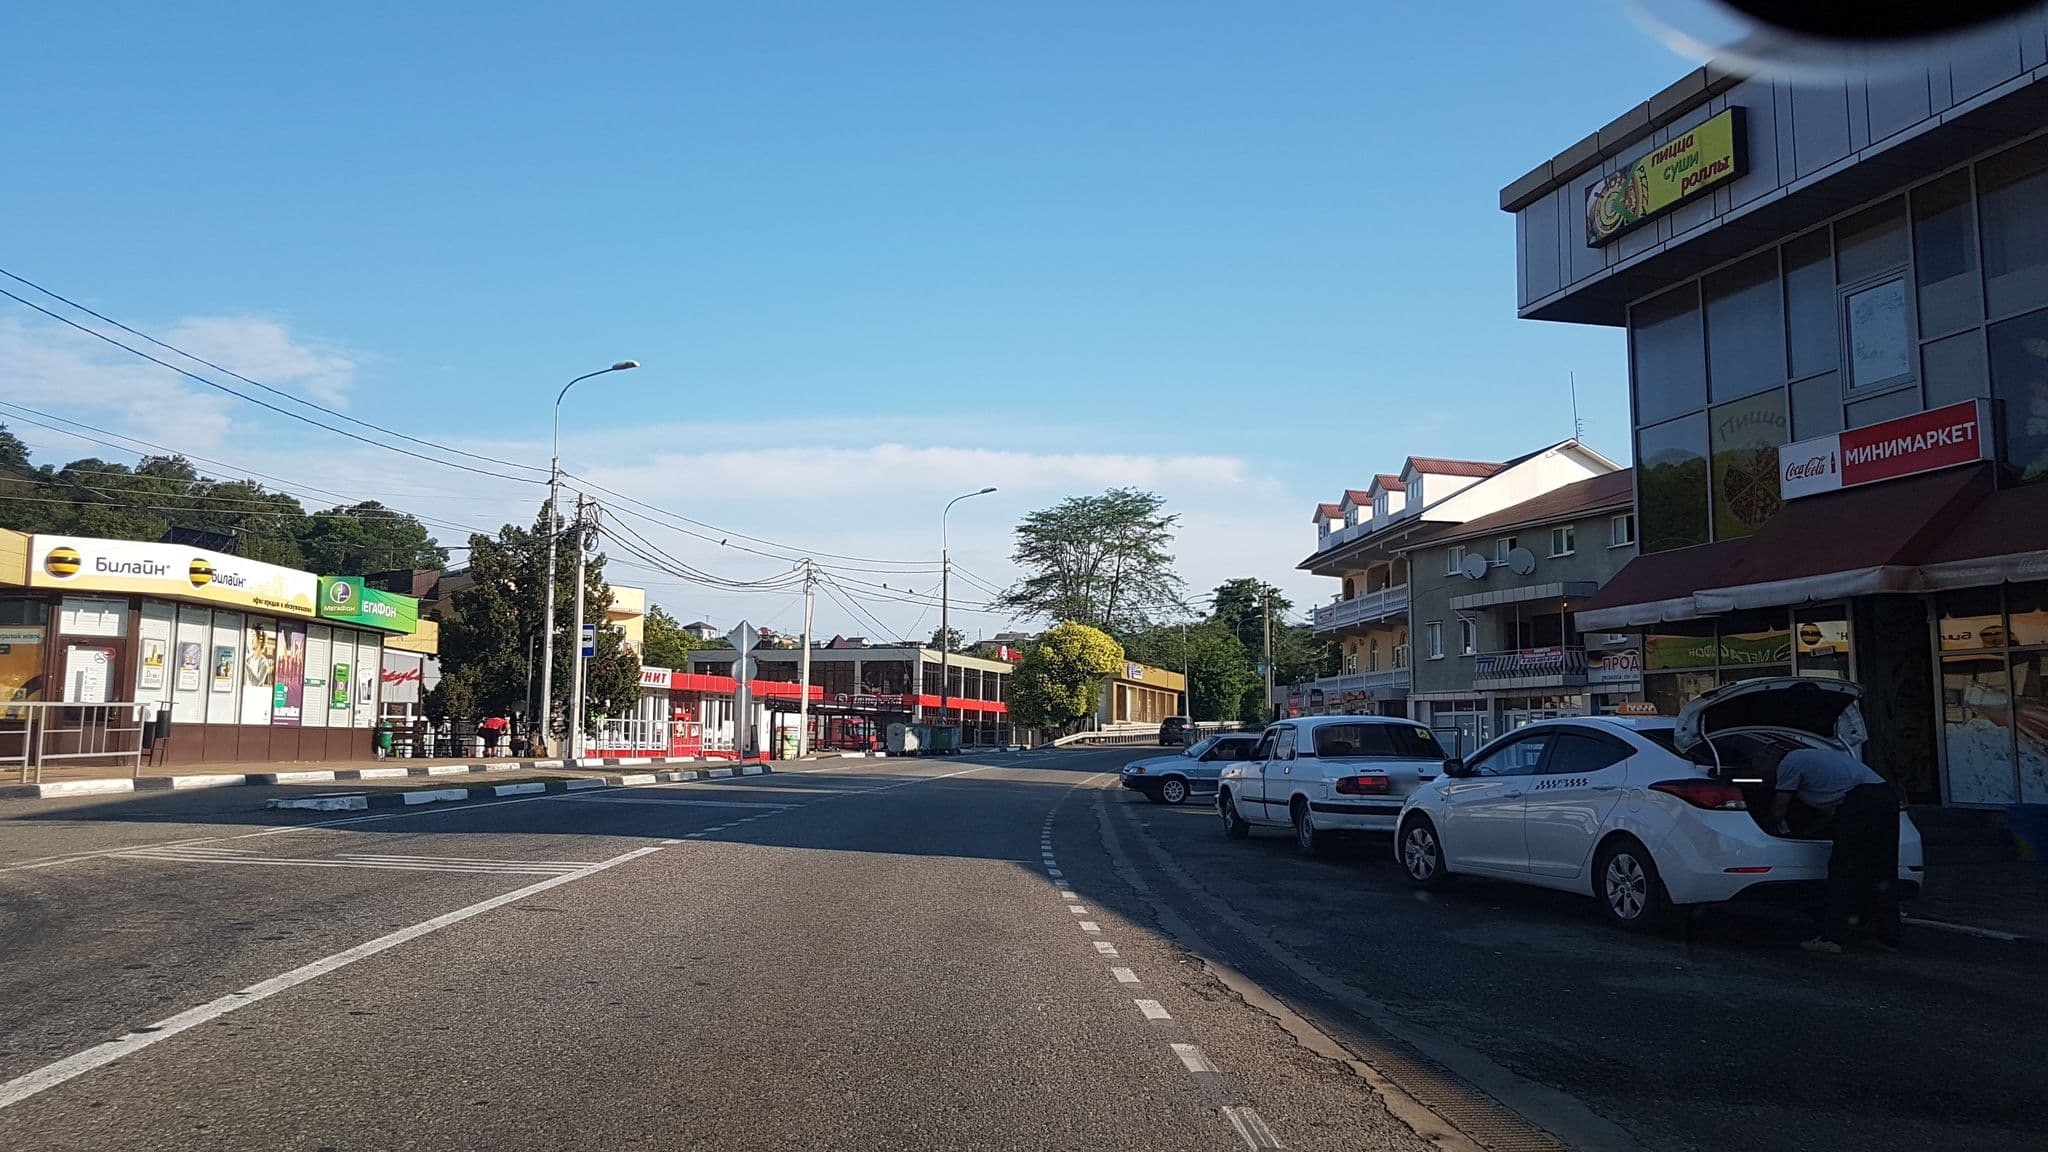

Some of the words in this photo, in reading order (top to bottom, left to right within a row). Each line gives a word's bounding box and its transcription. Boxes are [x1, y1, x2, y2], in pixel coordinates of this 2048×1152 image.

[1651, 134, 1694, 167] пицца
[1663, 151, 1699, 182] суши
[1681, 156, 1730, 198] роллы
[1845, 421, 1975, 467] МИНИМАРКЕТ
[95, 556, 166, 576] Билайн
[211, 568, 244, 588] Билайн
[361, 600, 397, 618] ЕГАФОН
[1602, 656, 1640, 672] ПРОД
